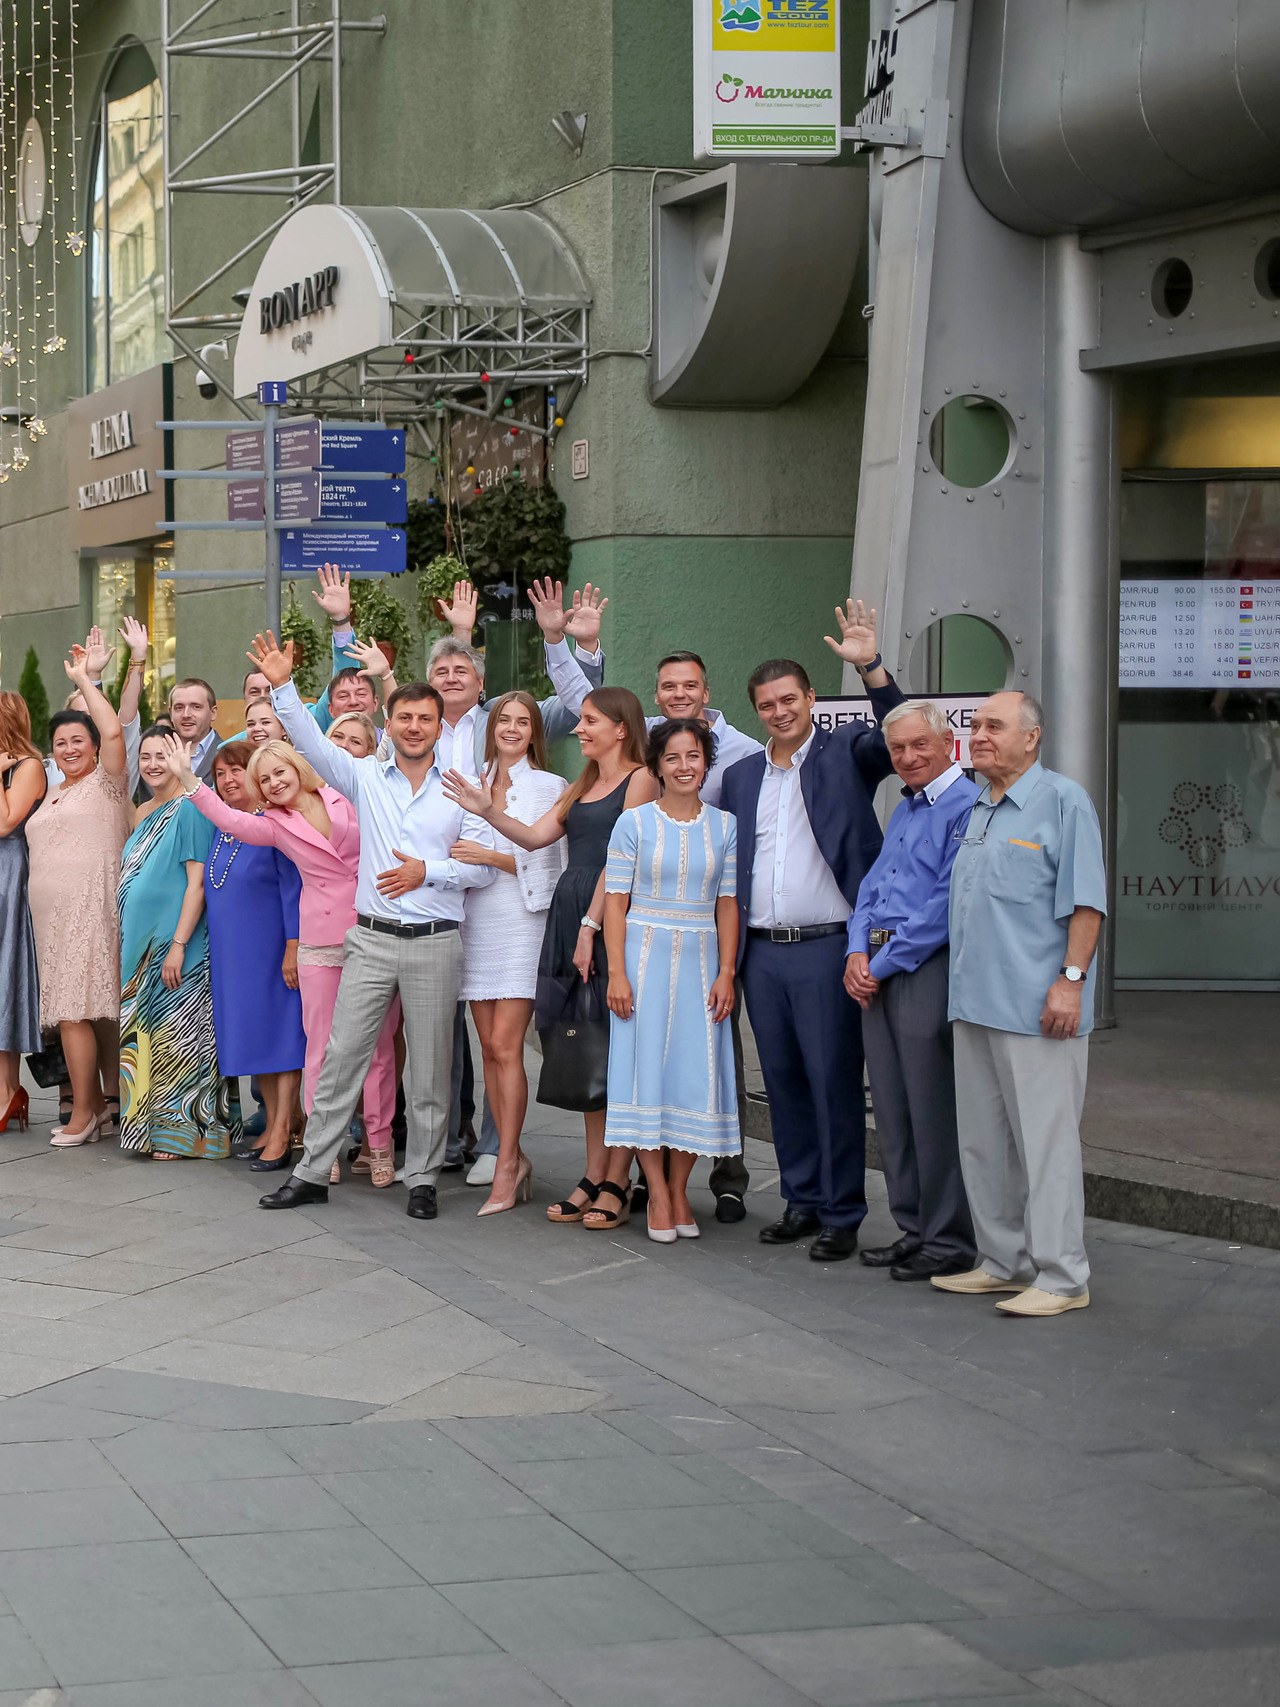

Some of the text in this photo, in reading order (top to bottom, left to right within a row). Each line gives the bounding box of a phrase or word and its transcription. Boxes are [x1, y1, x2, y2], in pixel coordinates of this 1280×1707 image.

[767, 0, 828, 11] TEZ
[744, 86, 833, 99] Малинка
[809, 135, 834, 143] ПР-ДА
[259, 266, 339, 334] BON APP
[89, 410, 132, 460] ALENA
[511, 608, 537, 621] 美味
[1146, 903, 1263, 912] ТОРГОВЫЙ ЦЕНТР
